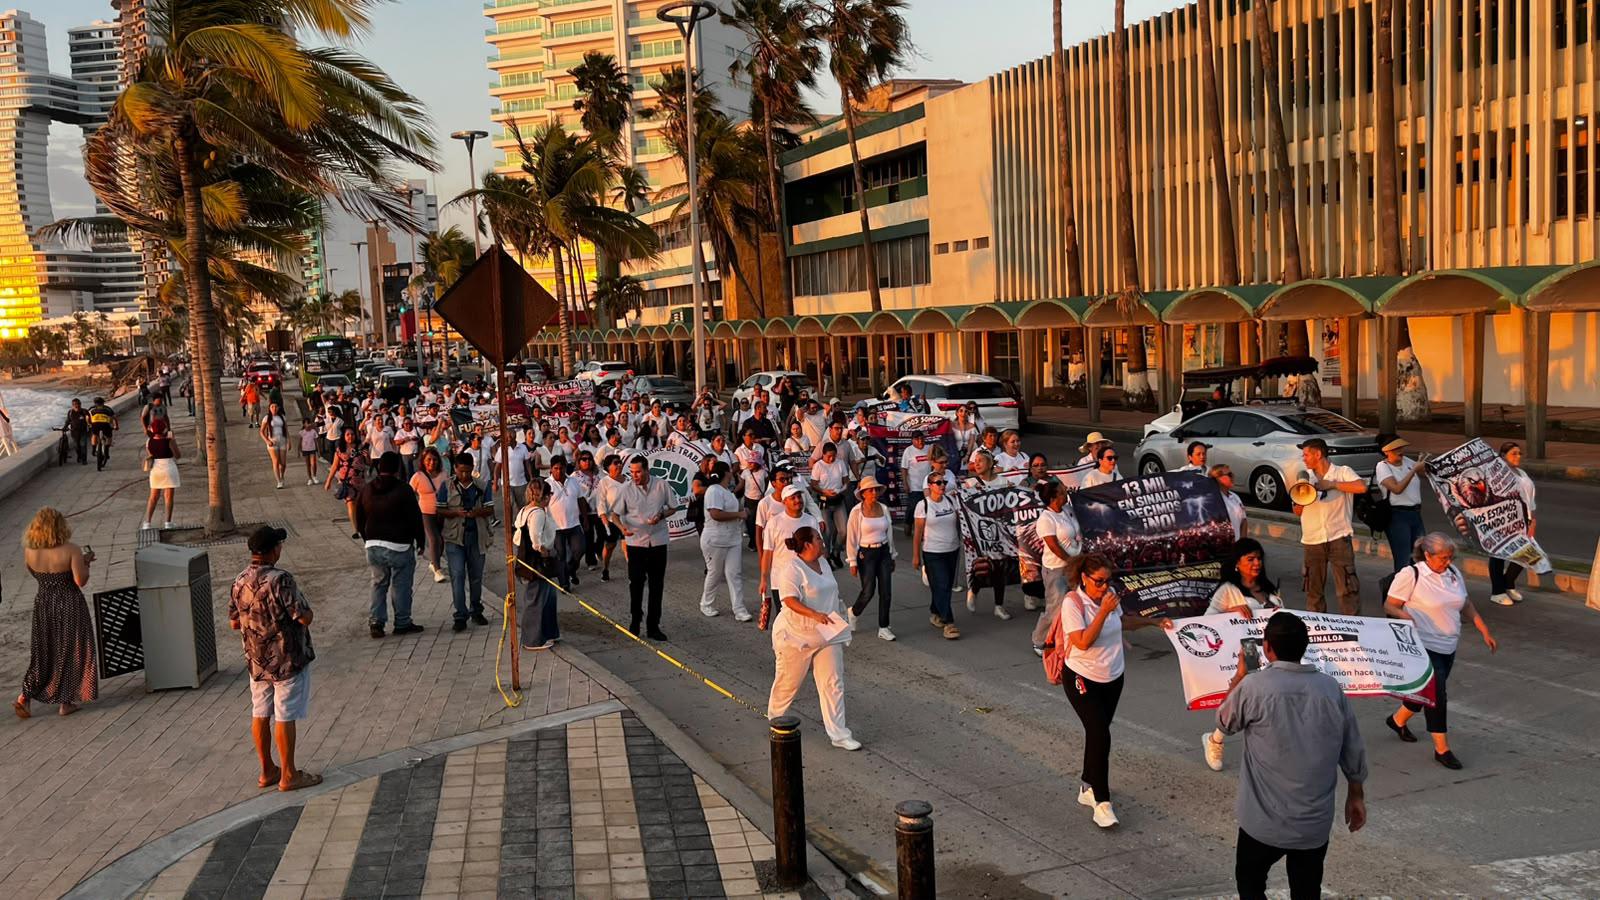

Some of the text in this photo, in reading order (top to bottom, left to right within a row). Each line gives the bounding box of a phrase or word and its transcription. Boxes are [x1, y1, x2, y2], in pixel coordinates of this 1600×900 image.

[1121, 476, 1168, 497] 13 MIL
[974, 491, 1031, 514] TODOS
[1117, 490, 1181, 509] EN SINALOA
[1011, 508, 1044, 524] JUNT
[1126, 500, 1182, 519] DECIMOS
[1471, 501, 1517, 525] NOS ESTAMOS
[1507, 511, 1518, 522] SIN
[1142, 514, 1176, 530] ¡NO!
[1125, 581, 1143, 591] QUE
[1314, 624, 1327, 632] de
[1329, 625, 1360, 633] Lucha
[1322, 615, 1365, 626] Nacional
[1308, 635, 1344, 643] SINALOA
